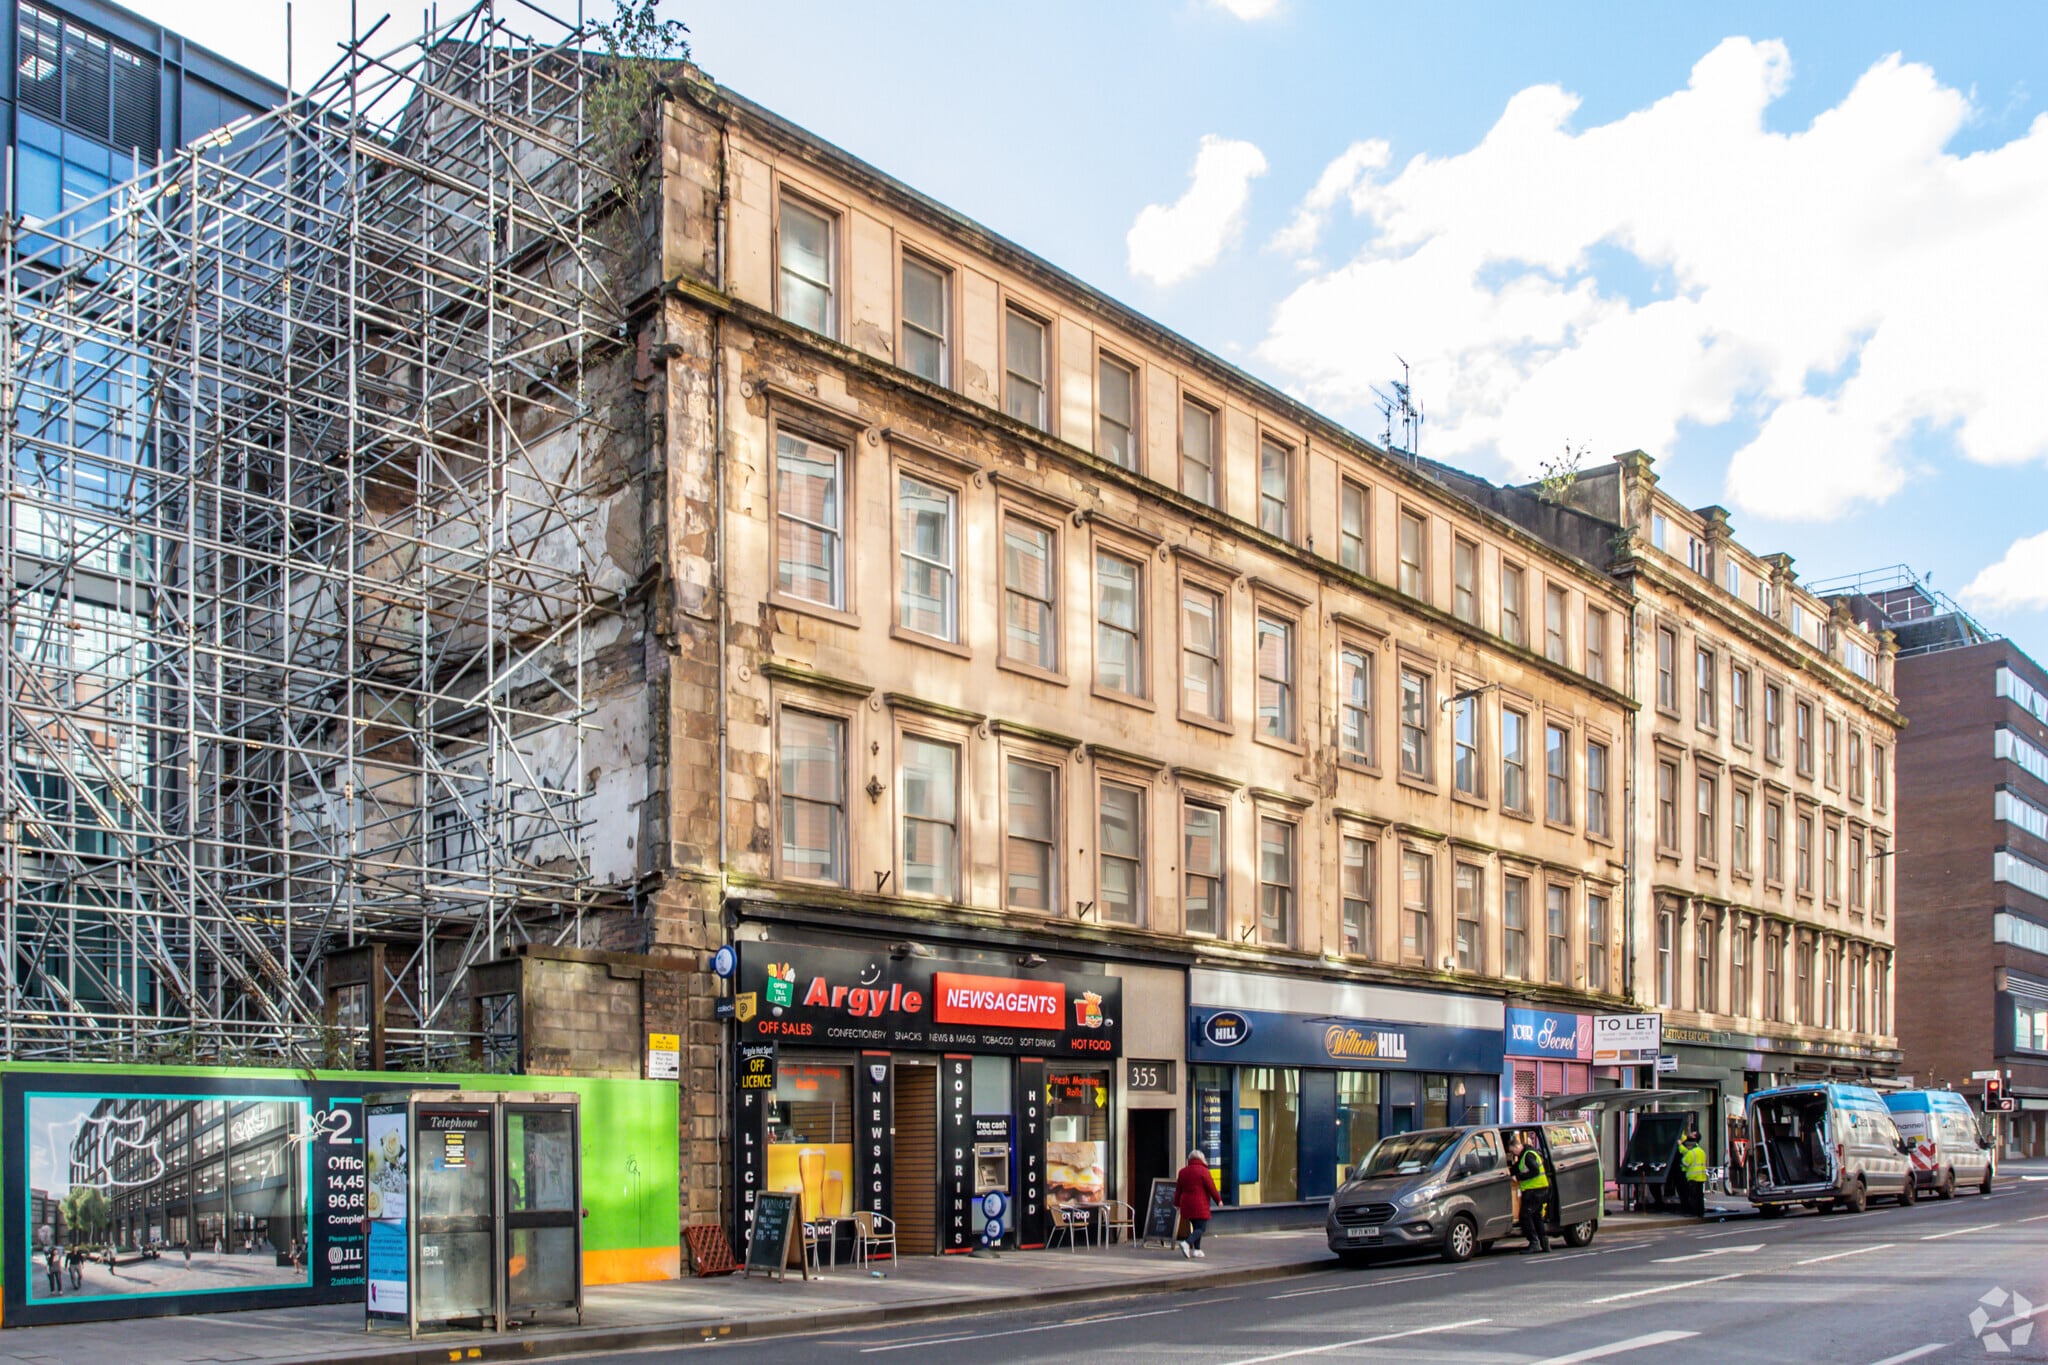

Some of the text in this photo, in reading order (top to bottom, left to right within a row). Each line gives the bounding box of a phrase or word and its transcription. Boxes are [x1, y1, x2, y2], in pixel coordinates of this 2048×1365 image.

[803, 976, 922, 1017] Argyle
[946, 988, 1057, 1014] NEWSAGENTS
[758, 1020, 812, 1036] OFF SALES
[1598, 1018, 1656, 1031] TO LET
[827, 1027, 887, 1039] CONFECTIONERY
[895, 1031, 922, 1041] SNACKS
[929, 1033, 948, 1042] NEWS
[956, 1035, 976, 1044] MAGS
[982, 1035, 1014, 1046] TOBACCO
[1020, 1037, 1034, 1047] SOFT
[1035, 1038, 1056, 1048] DRINKS
[1215, 1027, 1237, 1040] HILL
[1538, 1018, 1576, 1050] Secret
[1071, 1039, 1112, 1051] HOT FOOD
[1325, 1025, 1407, 1058] William HILL
[750, 1059, 765, 1072] OFF
[742, 1074, 772, 1089] LICENCE
[1050, 1074, 1099, 1088] Fresh Morning
[1131, 1067, 1157, 1087] 355
[1066, 1087, 1082, 1097] Rolls
[329, 1109, 352, 1144] 2
[430, 1116, 478, 1129] Telephone
[976, 1119, 1007, 1129] free cash
[955, 1063, 963, 1244] SOFT DRINKS
[1028, 1090, 1036, 1215] HOT FOOD
[328, 1156, 364, 1170] Offic
[343, 1248, 363, 1261] JLL
